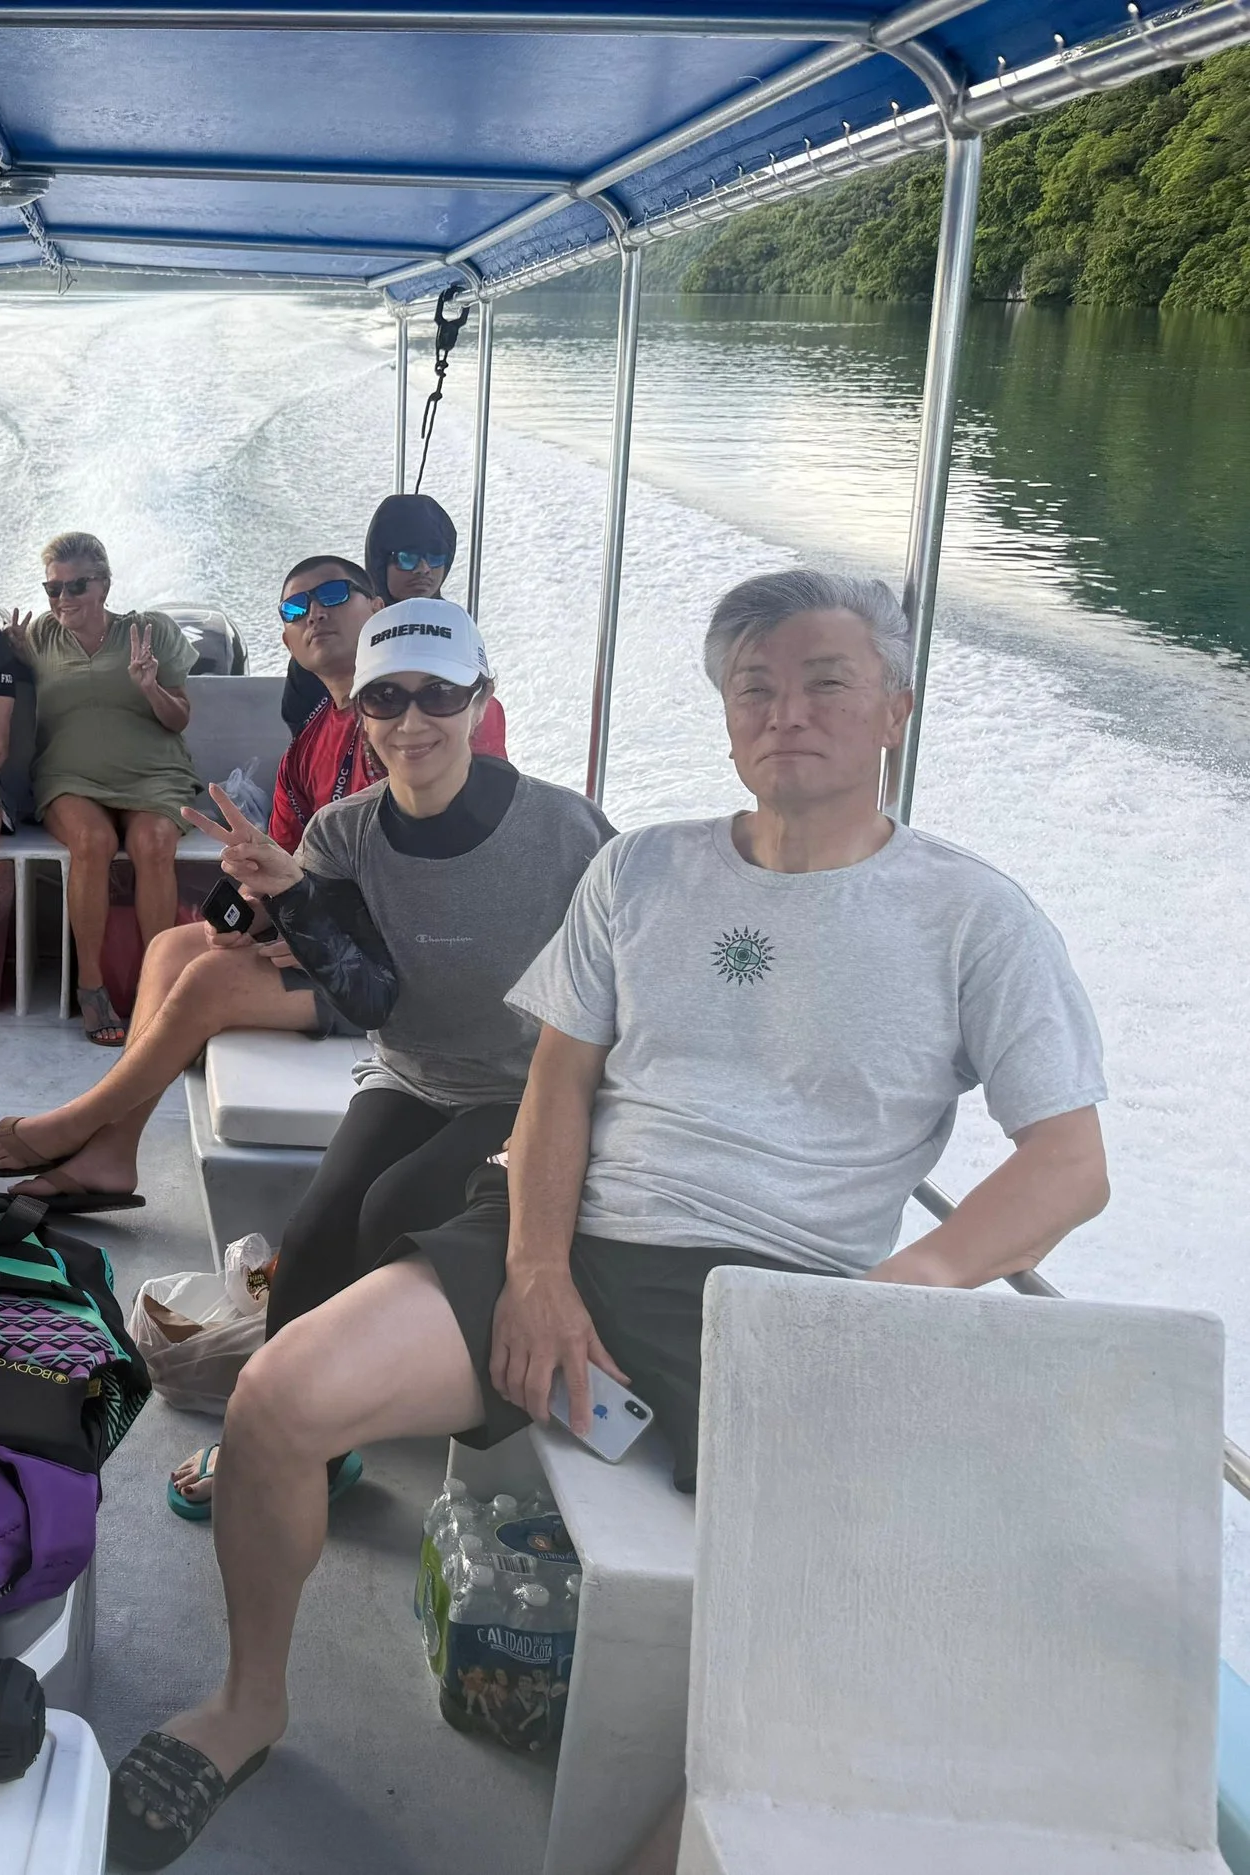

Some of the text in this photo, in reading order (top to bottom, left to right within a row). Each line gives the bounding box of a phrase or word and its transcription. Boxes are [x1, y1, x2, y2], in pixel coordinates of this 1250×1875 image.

[370, 624, 452, 647] BRIEFING
[332, 768, 349, 802] ONOC
[8, 1361, 53, 1380] BODY
[477, 1627, 532, 1657] CALIDAD
